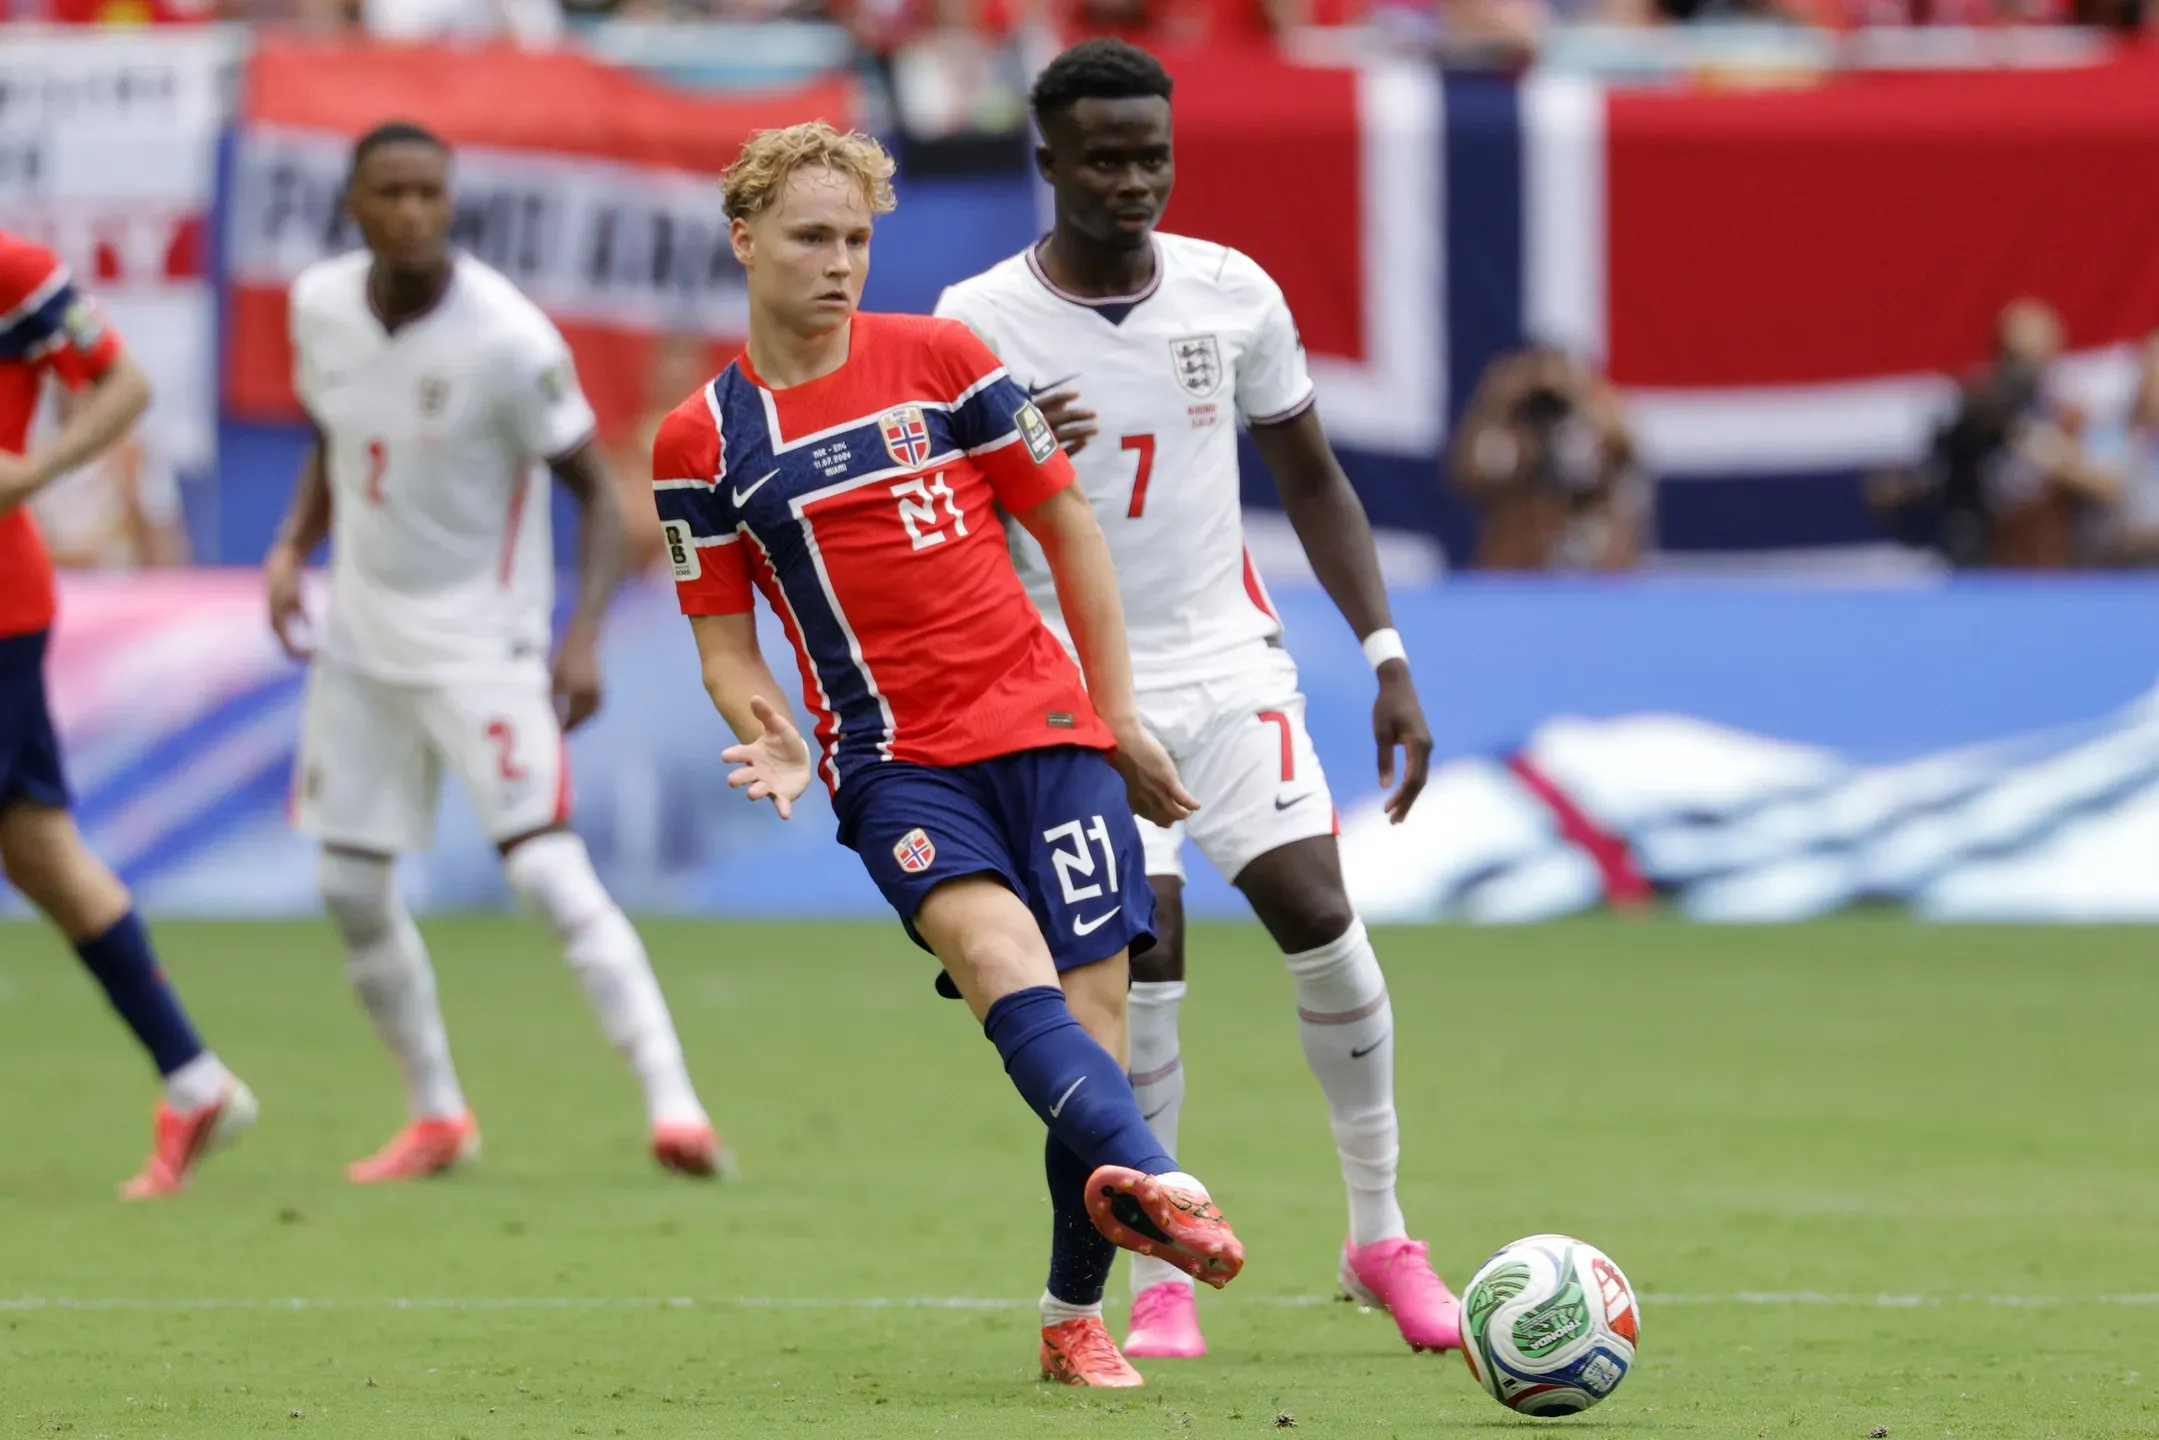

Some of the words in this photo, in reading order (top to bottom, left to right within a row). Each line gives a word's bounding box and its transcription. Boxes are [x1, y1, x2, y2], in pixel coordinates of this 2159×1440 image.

[366, 440, 389, 505] 2
[825, 463, 848, 477] MIAMI
[1121, 433, 1155, 519] 7
[890, 471, 969, 551] 21
[486, 721, 523, 781] 2
[1257, 708, 1295, 782] 7
[1043, 815, 1119, 904] 21
[1529, 1319, 1583, 1350] TRIONDA
